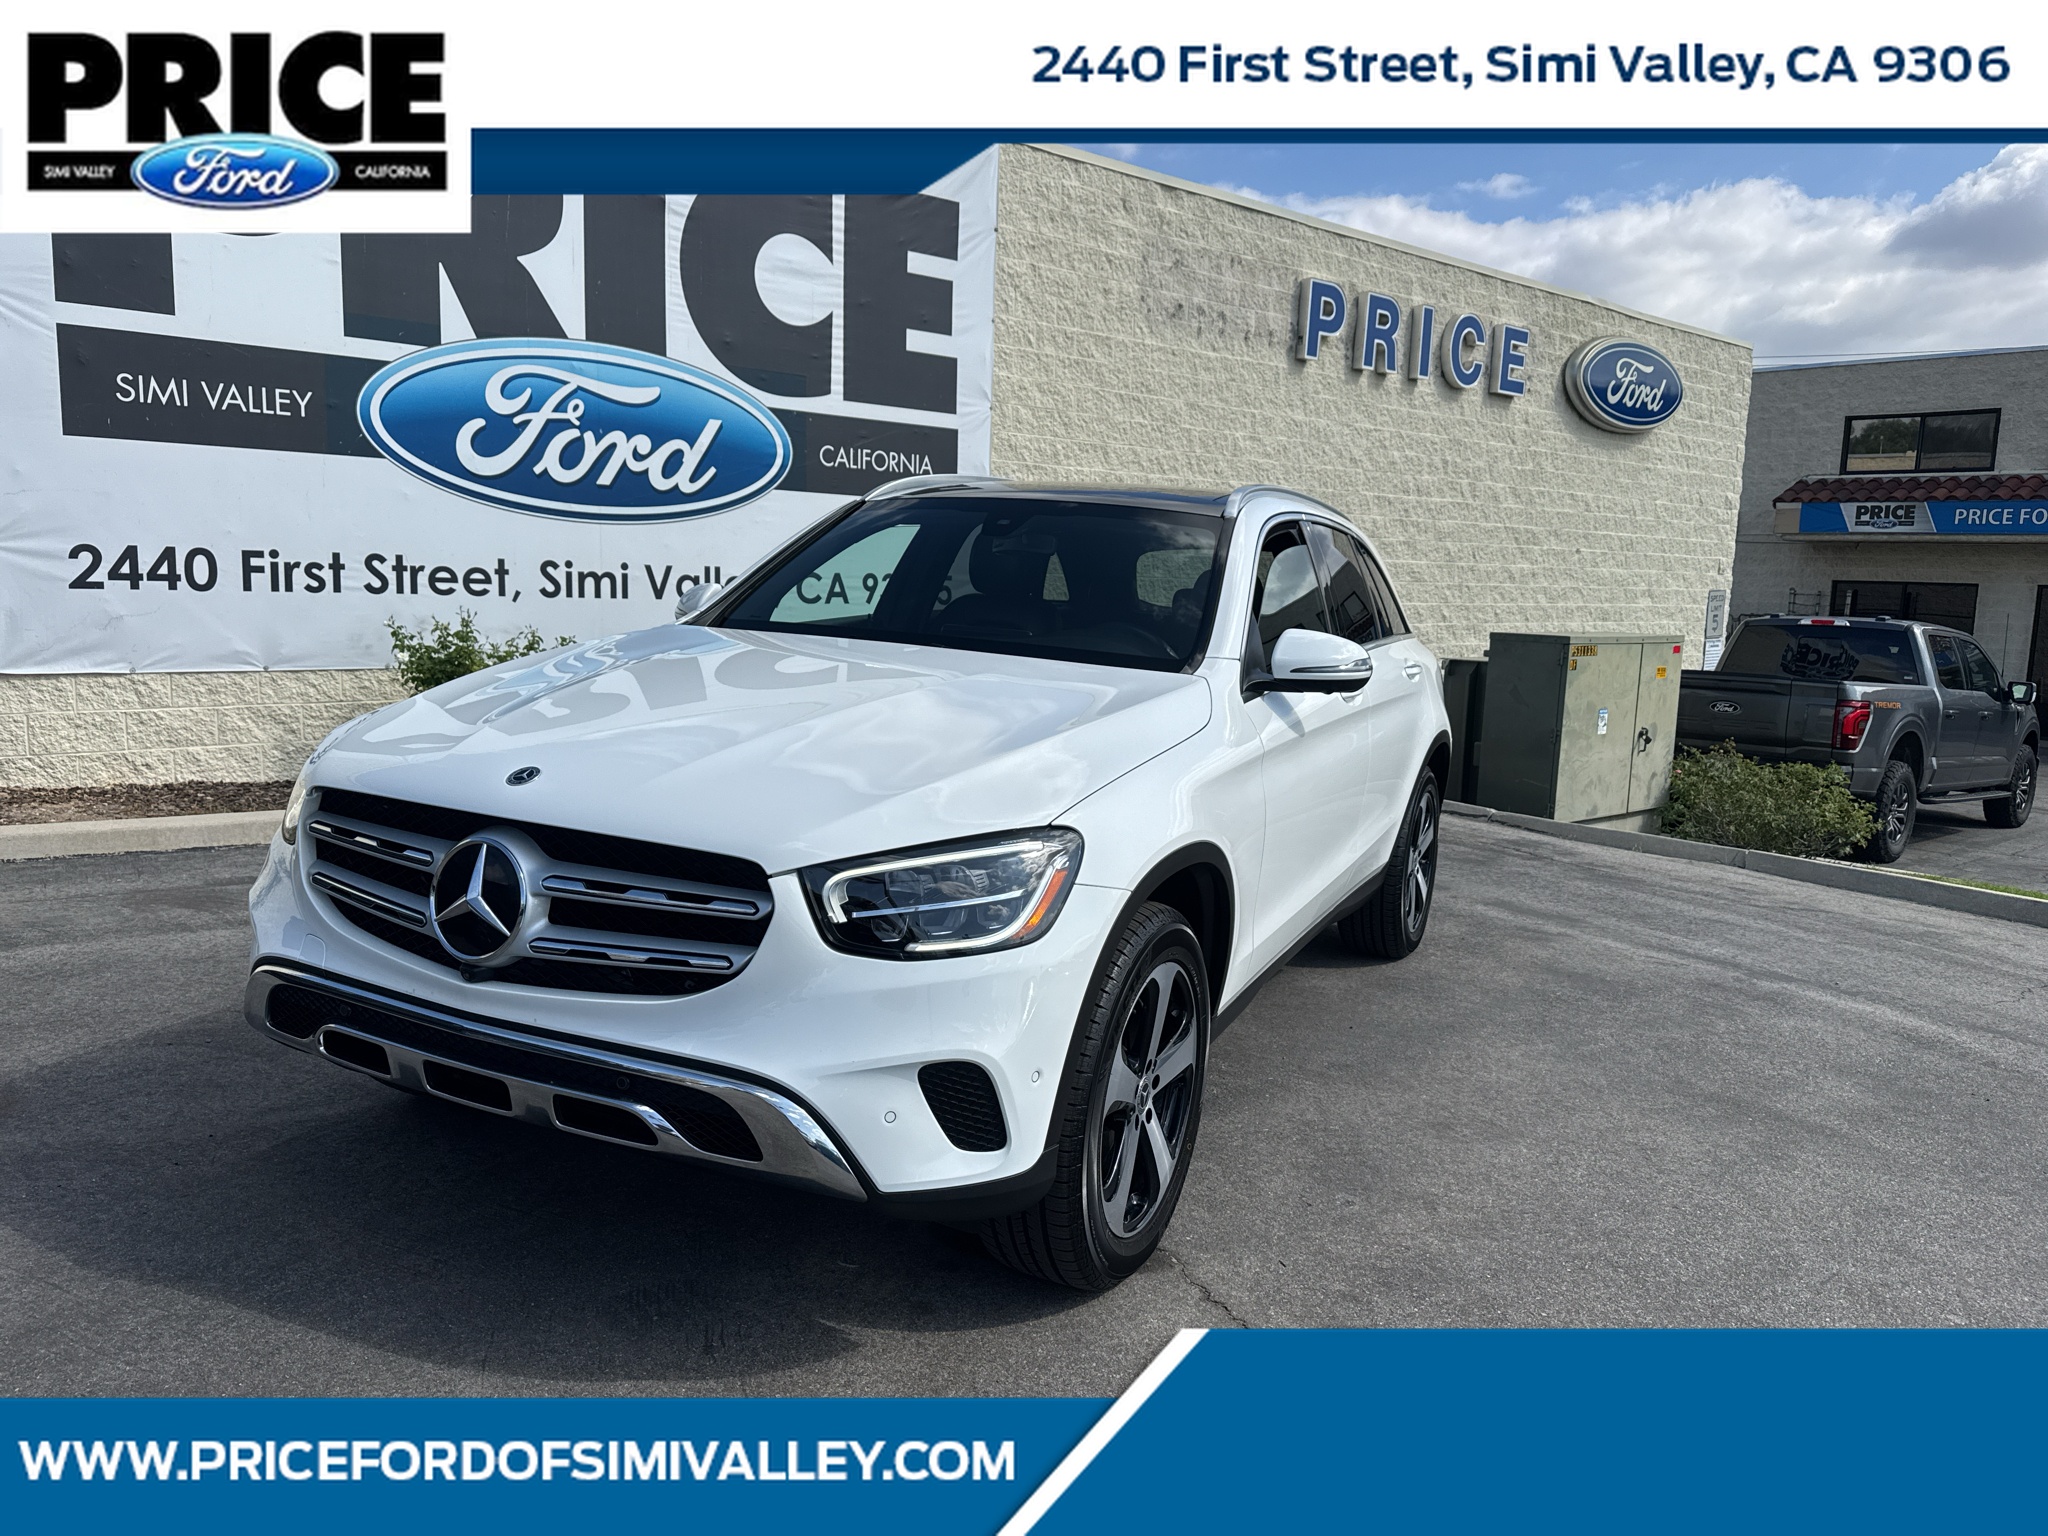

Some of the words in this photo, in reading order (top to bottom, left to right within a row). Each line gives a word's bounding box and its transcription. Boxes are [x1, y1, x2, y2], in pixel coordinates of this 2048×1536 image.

[1297, 277, 1531, 397] PRICE
[115, 372, 189, 407] SIMI
[200, 380, 313, 418] VALLEY
[1606, 357, 1668, 412] Ford
[455, 364, 723, 494] Ford
[819, 444, 934, 476] CALIFORNIA
[1855, 504, 1917, 520] PRICE
[1954, 508, 2014, 525] PRICE
[67, 543, 219, 592] 2440
[240, 548, 346, 594] First
[362, 552, 522, 603] Street,
[538, 558, 630, 600] Simi
[1714, 703, 1735, 712] Ford
[1874, 701, 1902, 709] TREMOR
